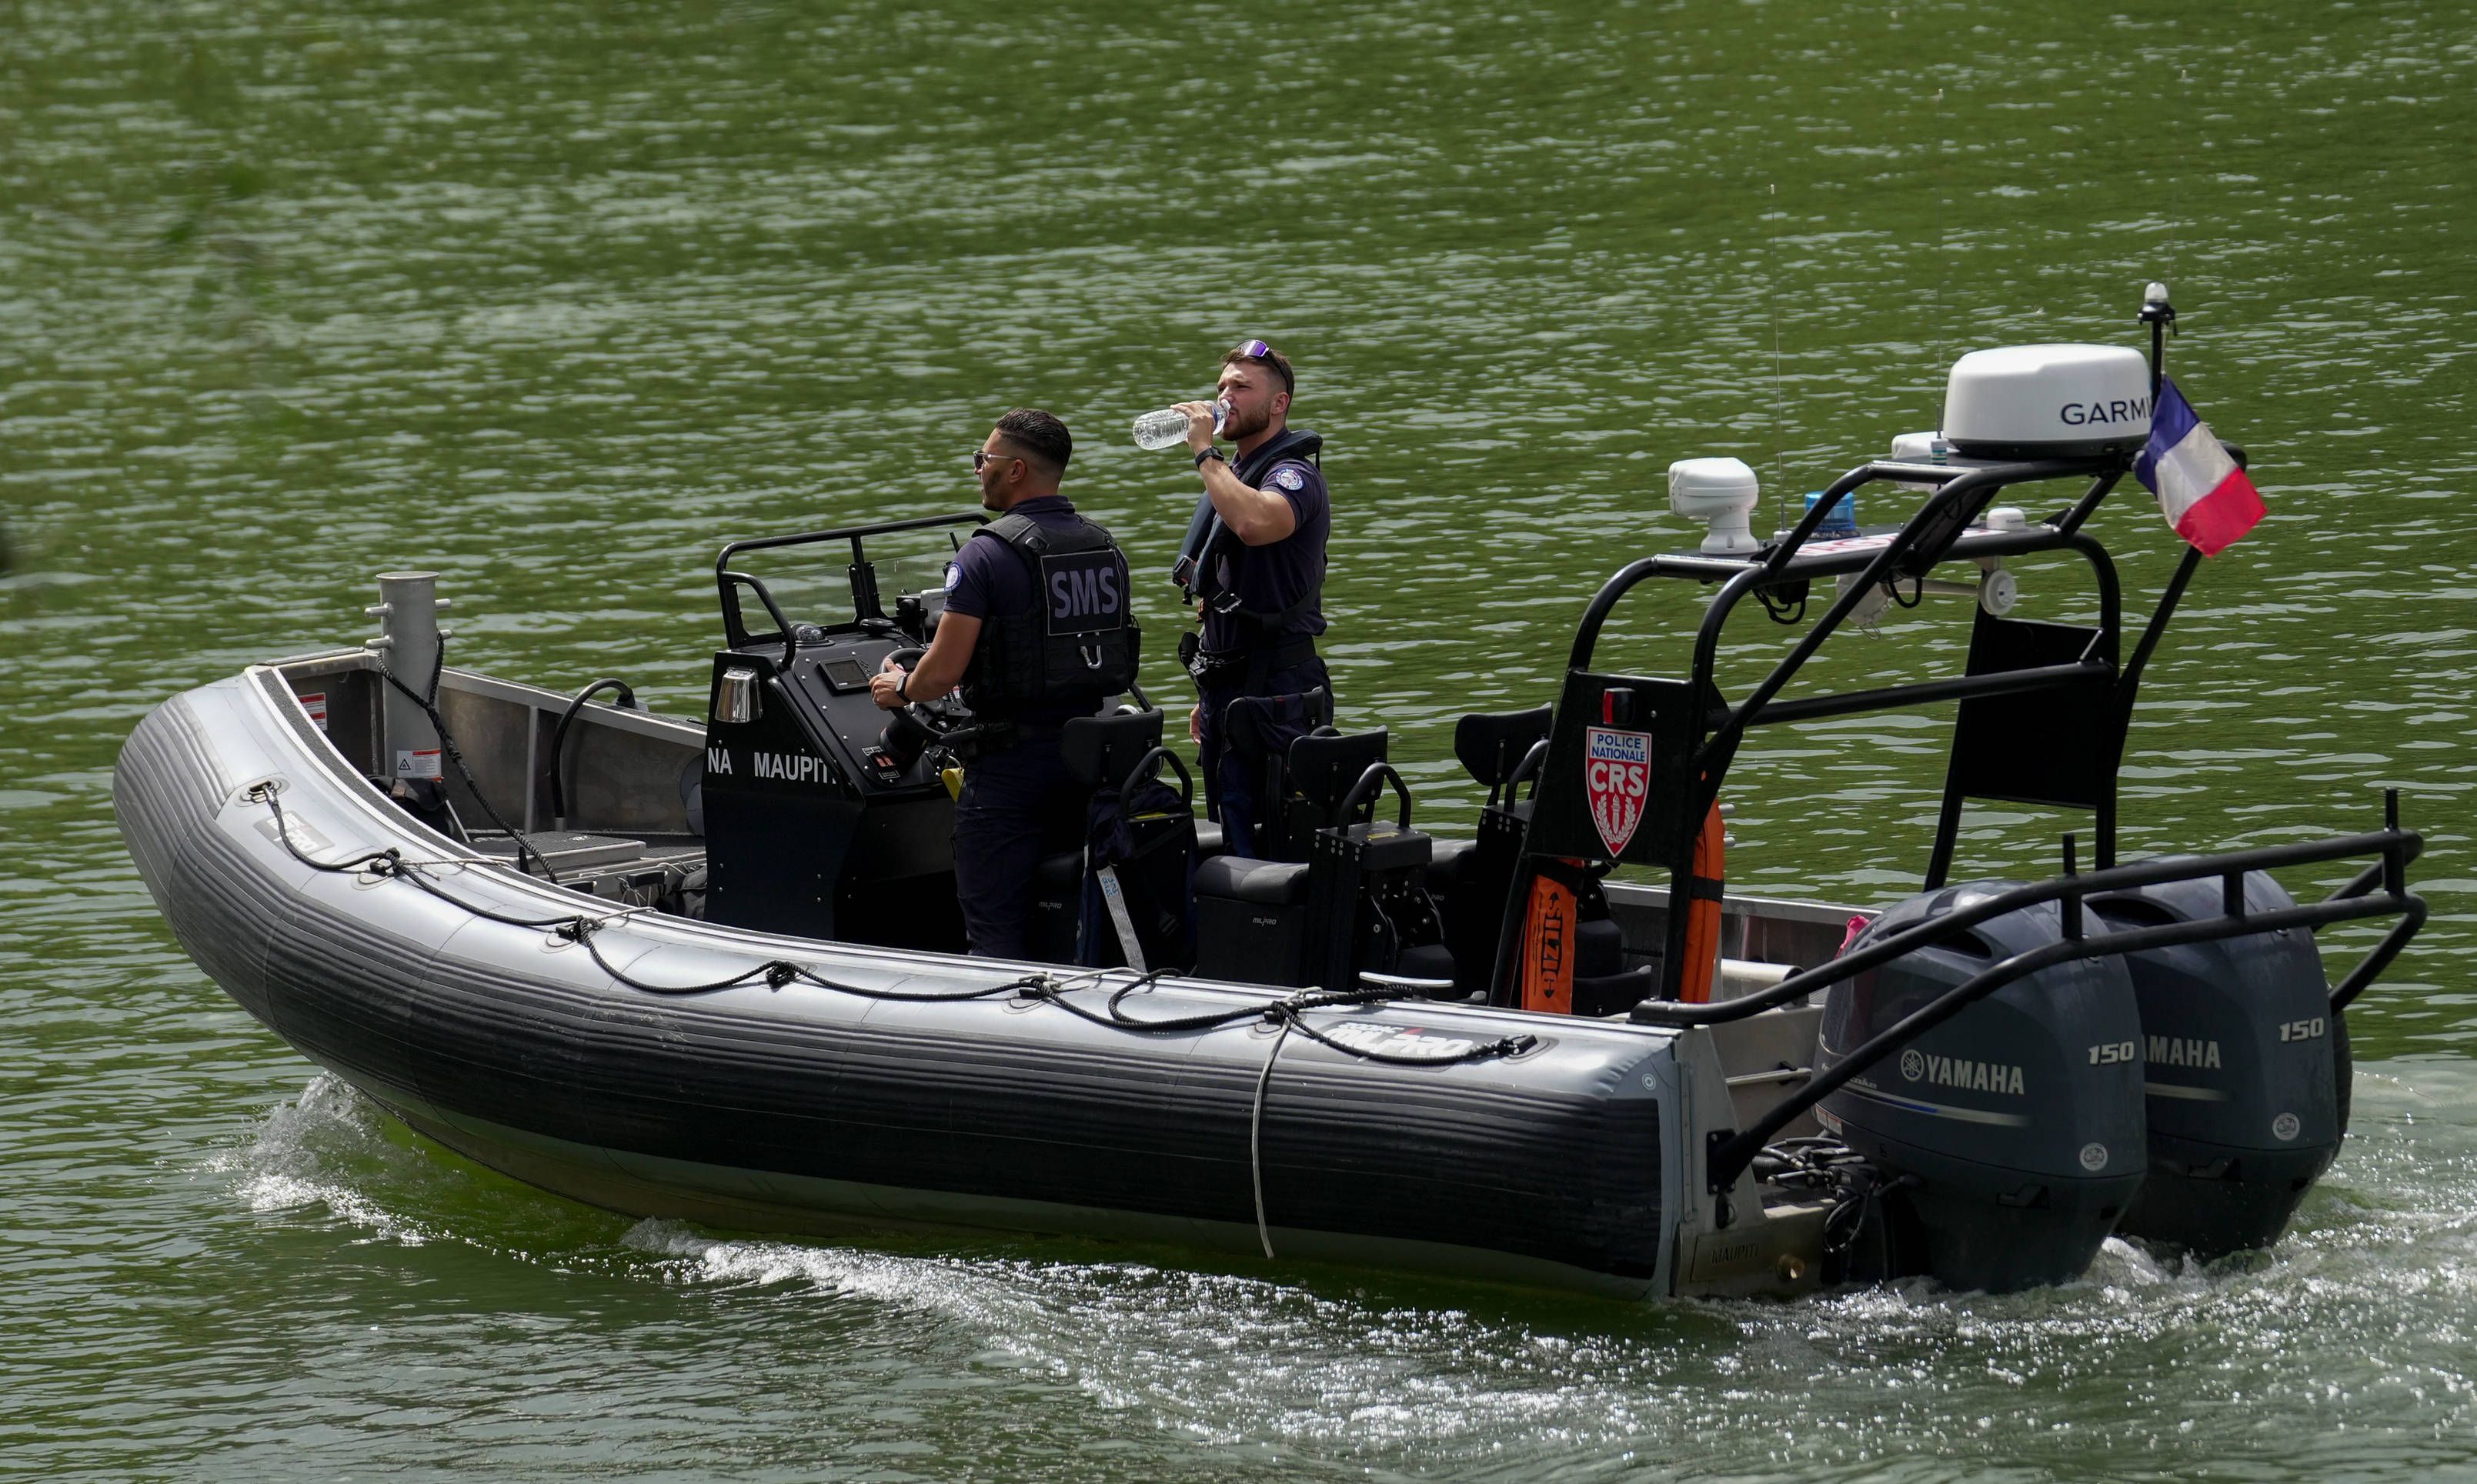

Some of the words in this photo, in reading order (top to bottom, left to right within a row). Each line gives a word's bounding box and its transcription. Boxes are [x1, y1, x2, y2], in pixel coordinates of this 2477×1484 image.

[2061, 396, 2153, 425] GARMI
[1051, 566, 1119, 619] SMS
[1591, 745, 1646, 762] NATIONALE
[1597, 734, 1641, 749] POLICE
[708, 747, 733, 775] NA
[753, 752, 837, 785] MAUPIT
[1589, 761, 1644, 797] CRS
[2278, 1016, 2325, 1042] 150
[2088, 1040, 2135, 1065] 150
[1926, 1053, 2025, 1095] YAMAHA
